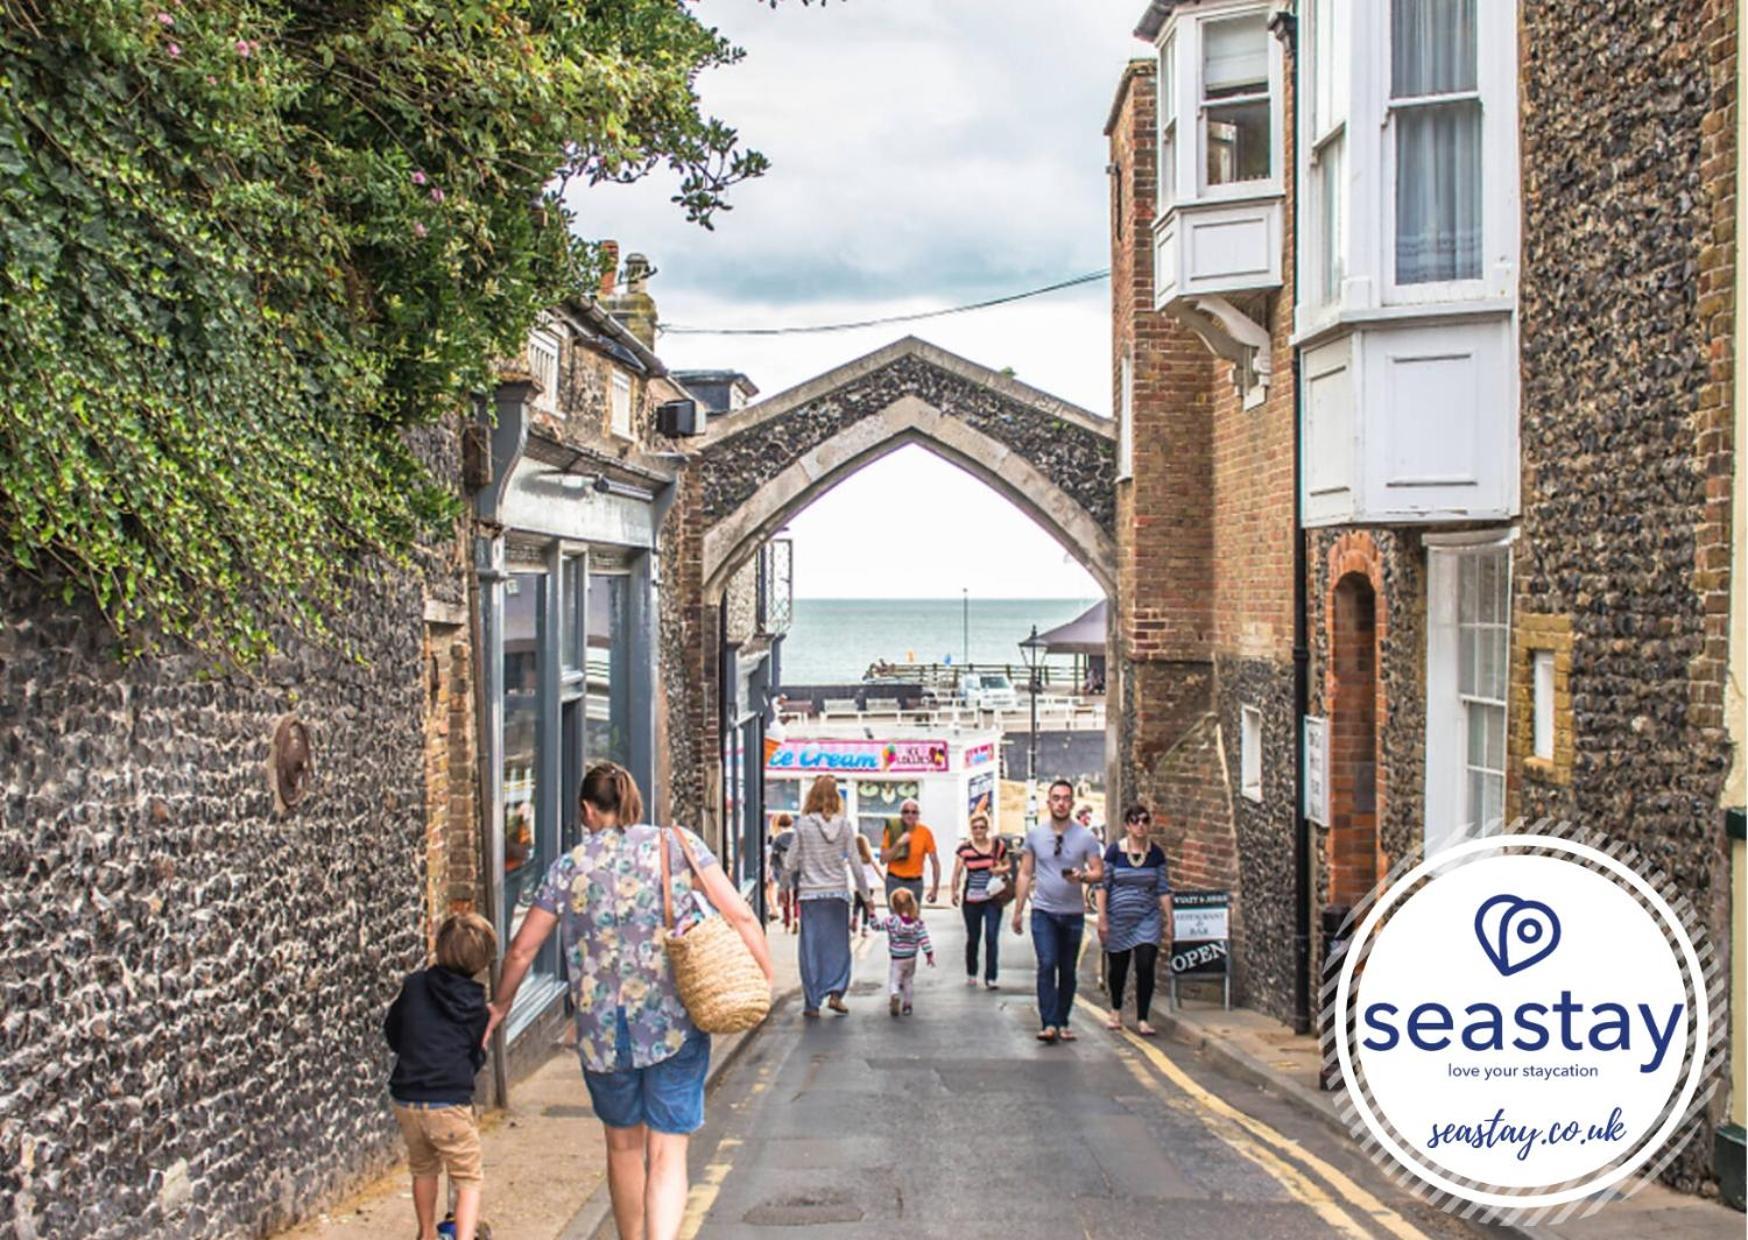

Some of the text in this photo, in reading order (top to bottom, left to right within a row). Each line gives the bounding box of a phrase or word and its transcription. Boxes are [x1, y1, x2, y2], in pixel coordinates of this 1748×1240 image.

[769, 745, 877, 768] ce Cream
[1171, 940, 1228, 972] OPEN
